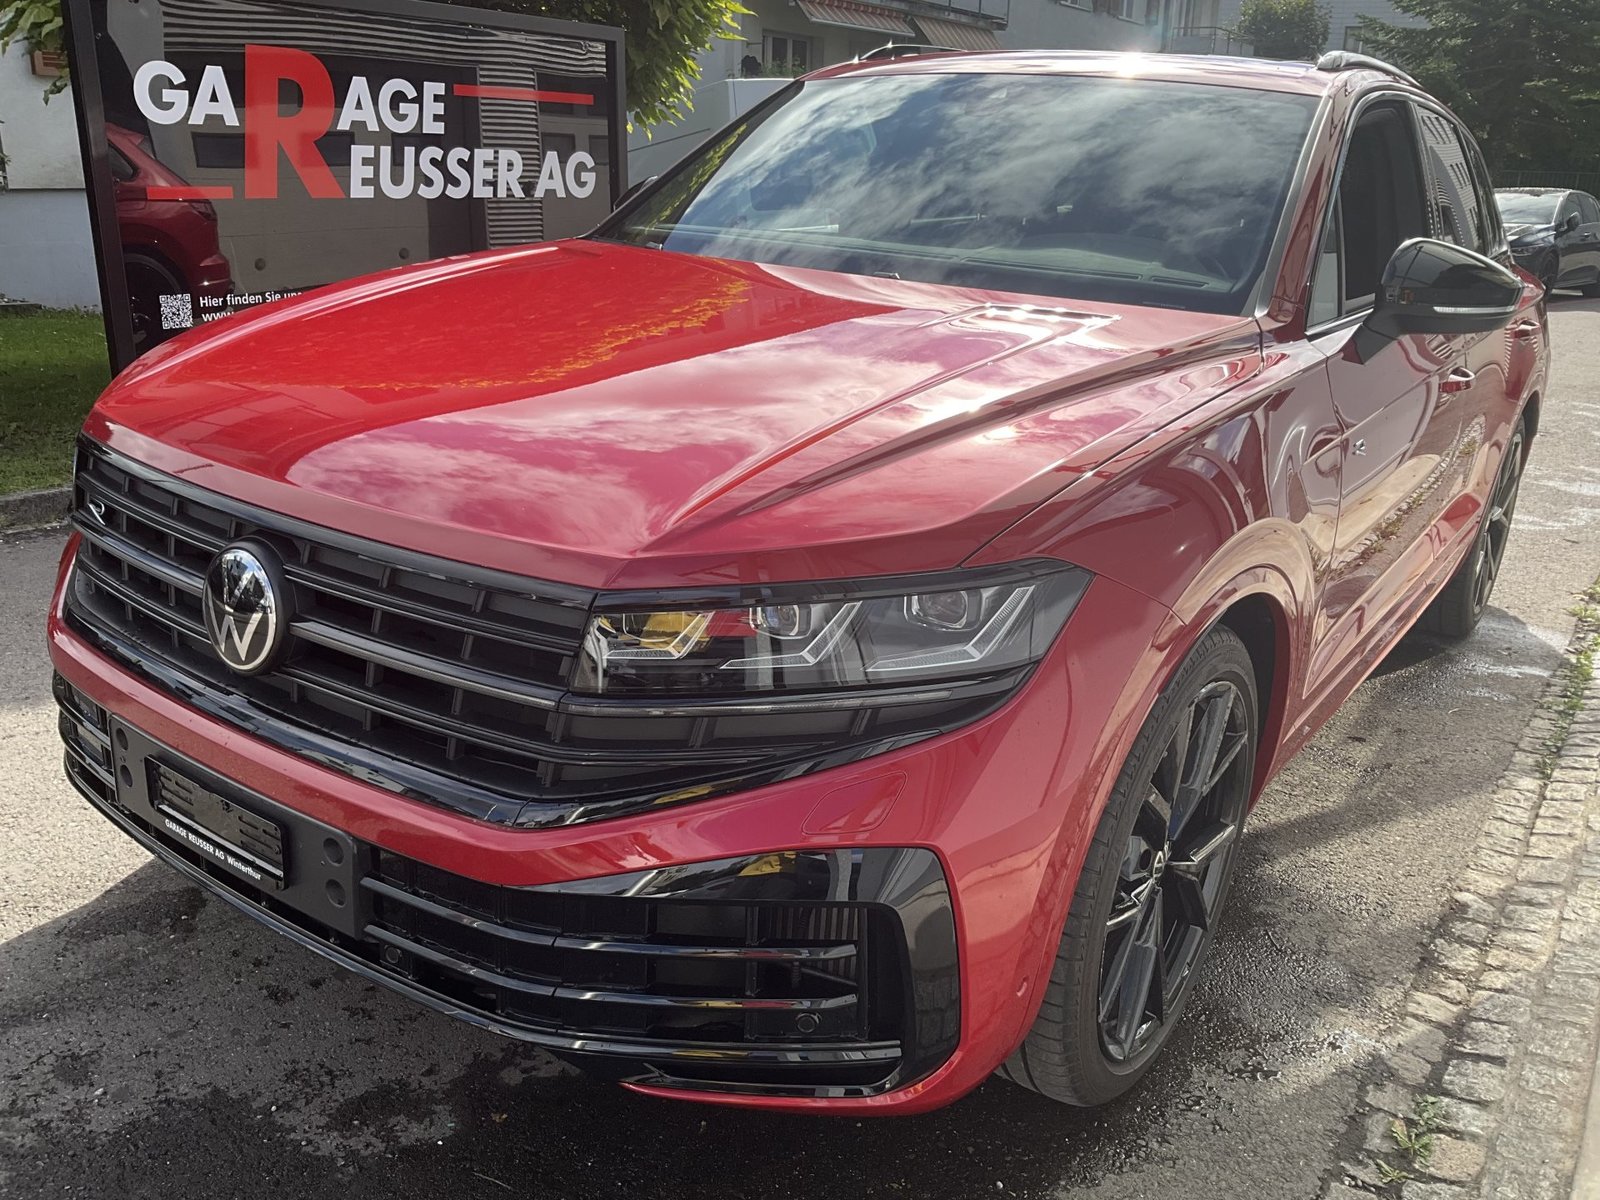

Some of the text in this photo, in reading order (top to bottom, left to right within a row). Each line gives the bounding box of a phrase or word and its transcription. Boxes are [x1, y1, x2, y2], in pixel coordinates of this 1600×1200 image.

[133, 44, 446, 199] GARAGE
[534, 151, 596, 199] AG
[199, 296, 223, 308] Hier
[226, 292, 262, 305] finden
[265, 291, 281, 303] Sie
[164, 818, 261, 880] GARAGE REUSSER AG Winterthur
